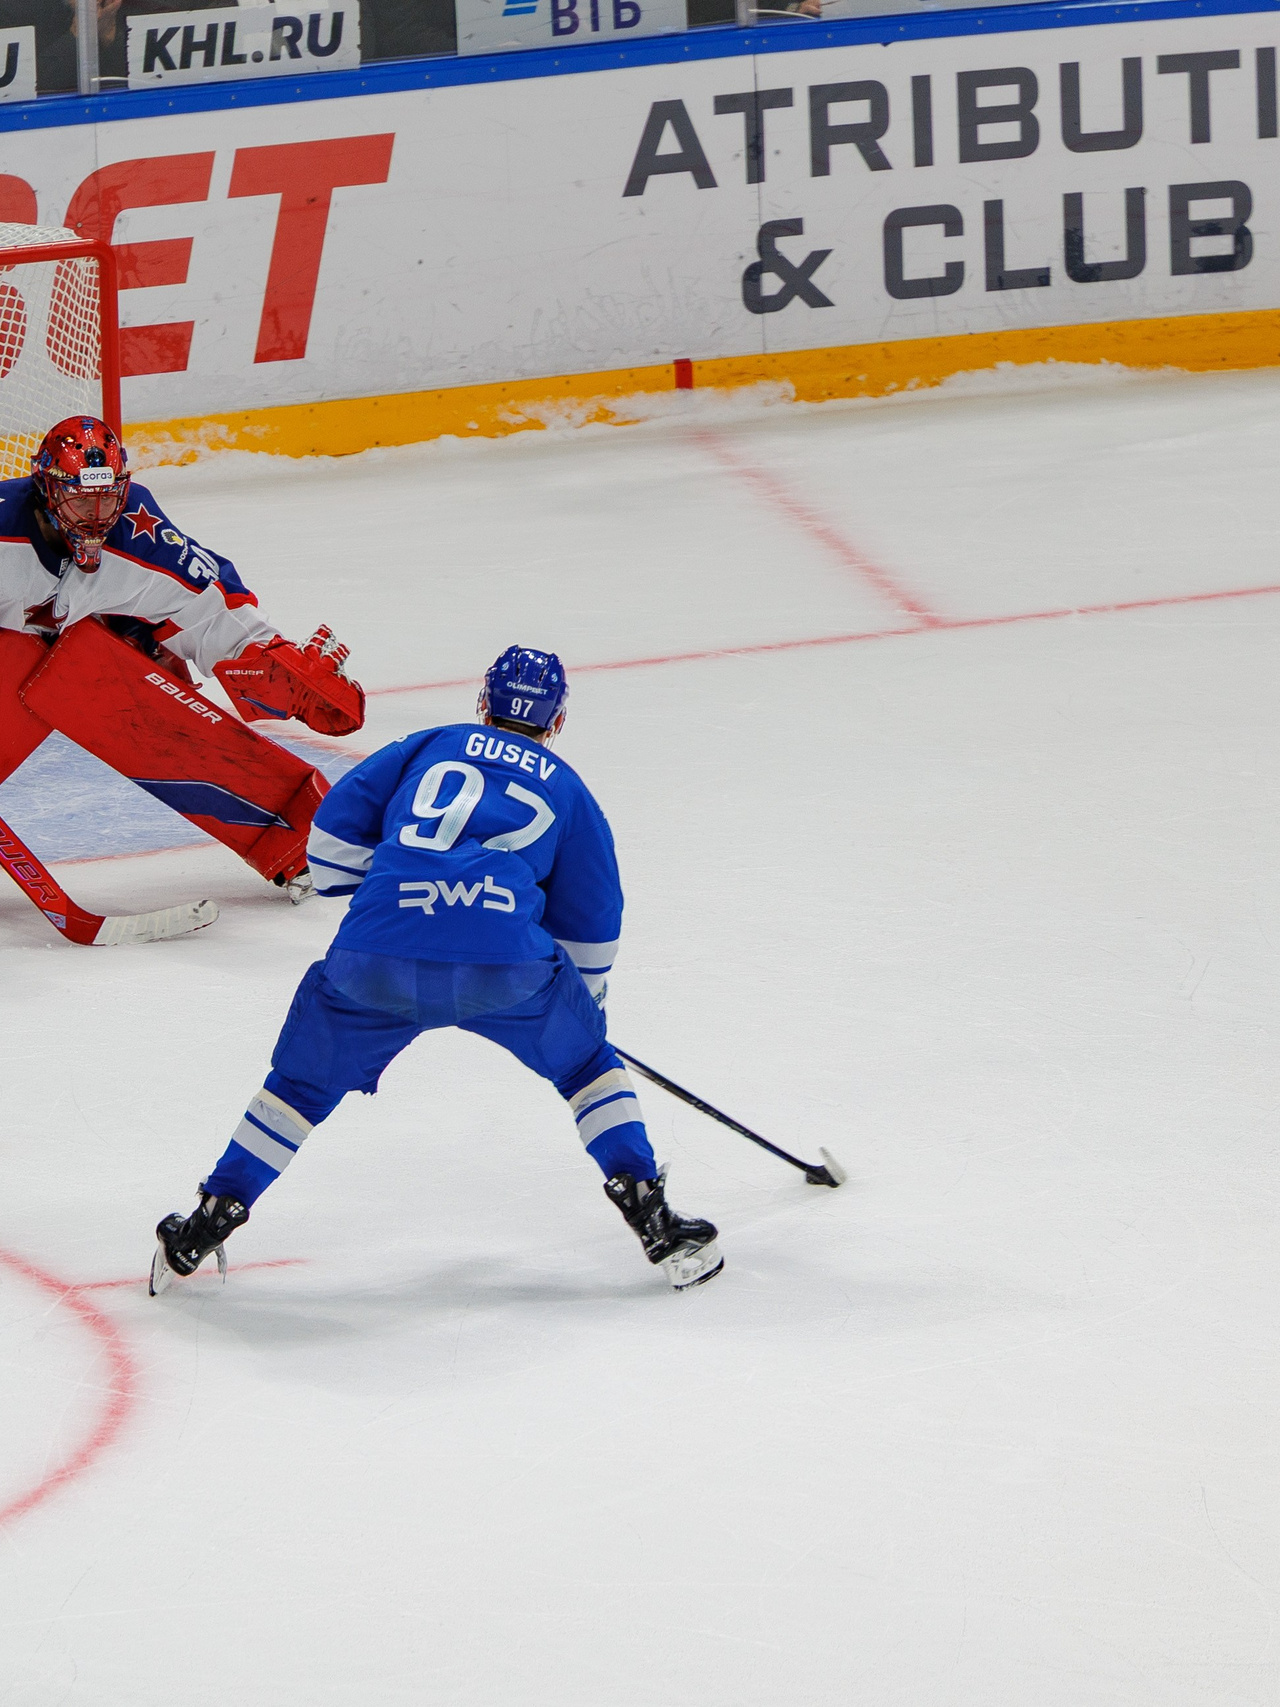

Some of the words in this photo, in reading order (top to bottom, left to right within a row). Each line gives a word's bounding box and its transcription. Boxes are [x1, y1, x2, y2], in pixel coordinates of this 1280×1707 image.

[143, 11, 345, 73] KHL.RU
[622, 47, 1278, 197] ATRIBUTI
[742, 217, 836, 315] &
[883, 179, 1253, 299] CLUB
[82, 472, 113, 481] согаз
[145, 672, 223, 725] BAUER
[506, 681, 548, 696] OLIMPBET
[510, 697, 534, 718] 97
[465, 732, 556, 781] GUSEV
[399, 760, 556, 852] 97
